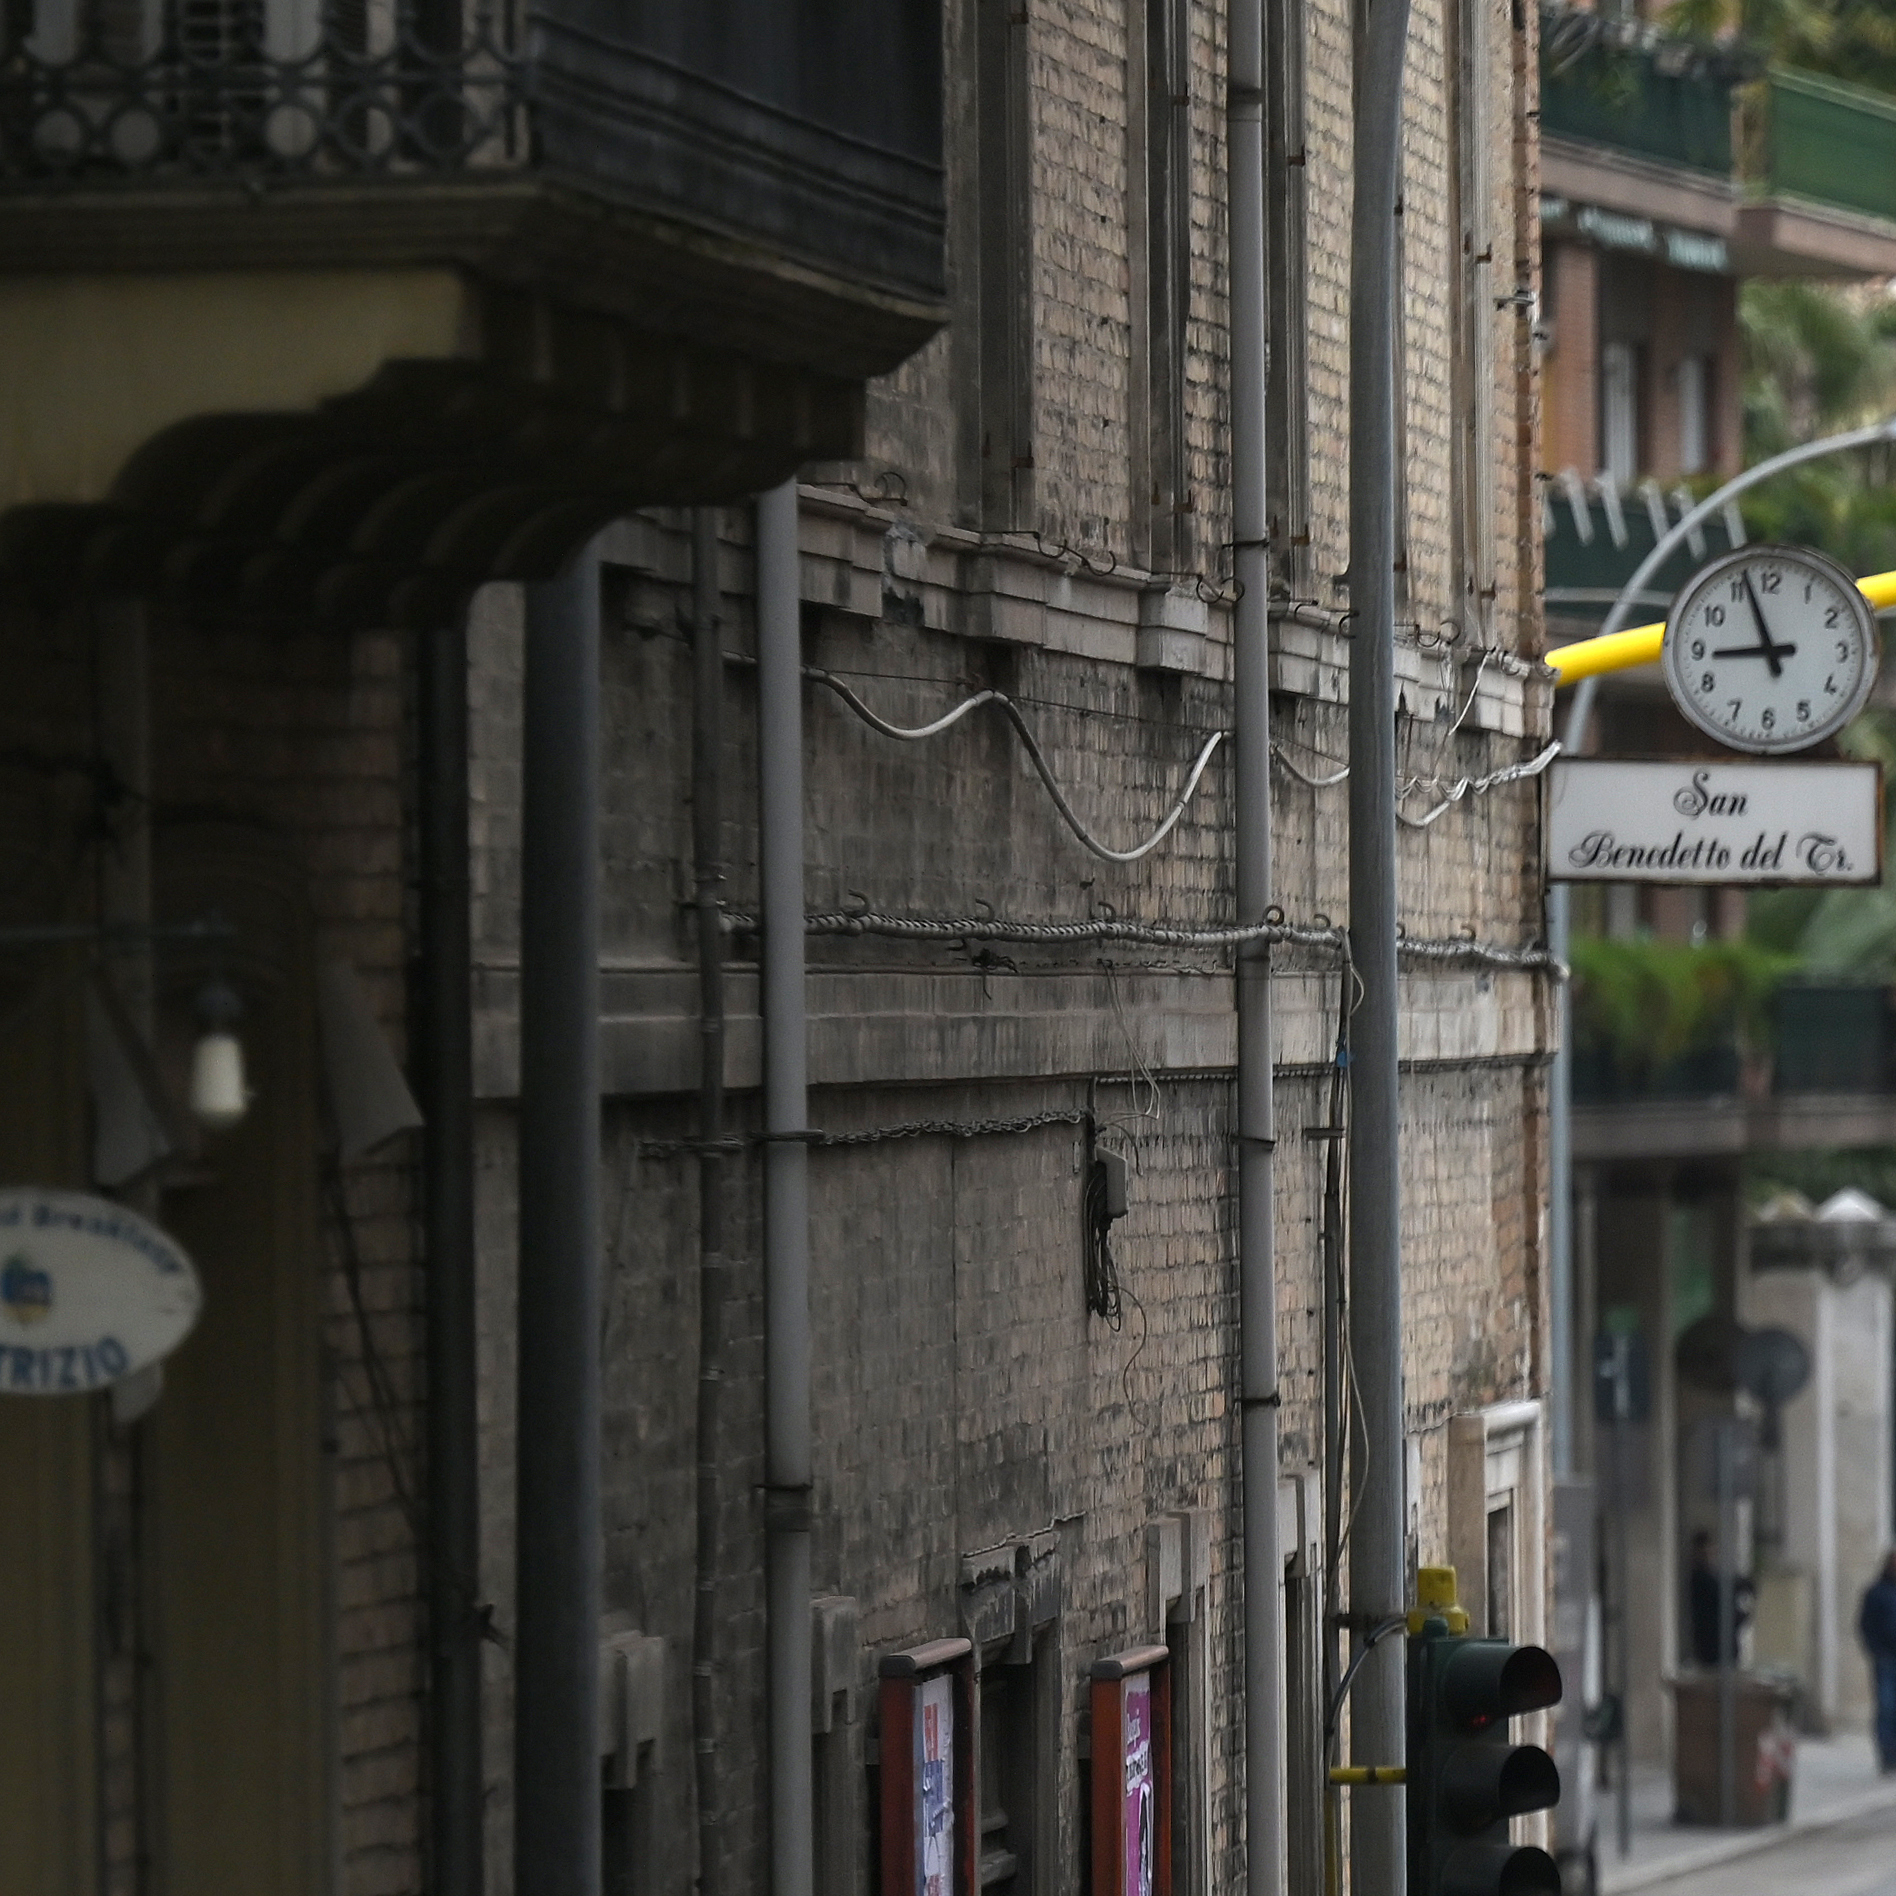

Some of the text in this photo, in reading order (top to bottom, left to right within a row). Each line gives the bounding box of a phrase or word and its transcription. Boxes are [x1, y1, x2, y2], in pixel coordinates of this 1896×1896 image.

[1761, 573, 1781, 594] 12
[1804, 583, 1811, 604] 1
[1704, 605, 1725, 627] 10
[1824, 608, 1838, 629] 2
[1691, 641, 1705, 660] 9
[1836, 642, 1848, 663] 3
[1701, 673, 1715, 693] 8
[1824, 674, 1837, 695] 4
[1728, 701, 1741, 722] 7
[1762, 708, 1775, 730] 6
[1797, 701, 1810, 722] 5
[1674, 771, 1748, 820] San
[1568, 830, 1854, 875] Benedetto del Tr.
